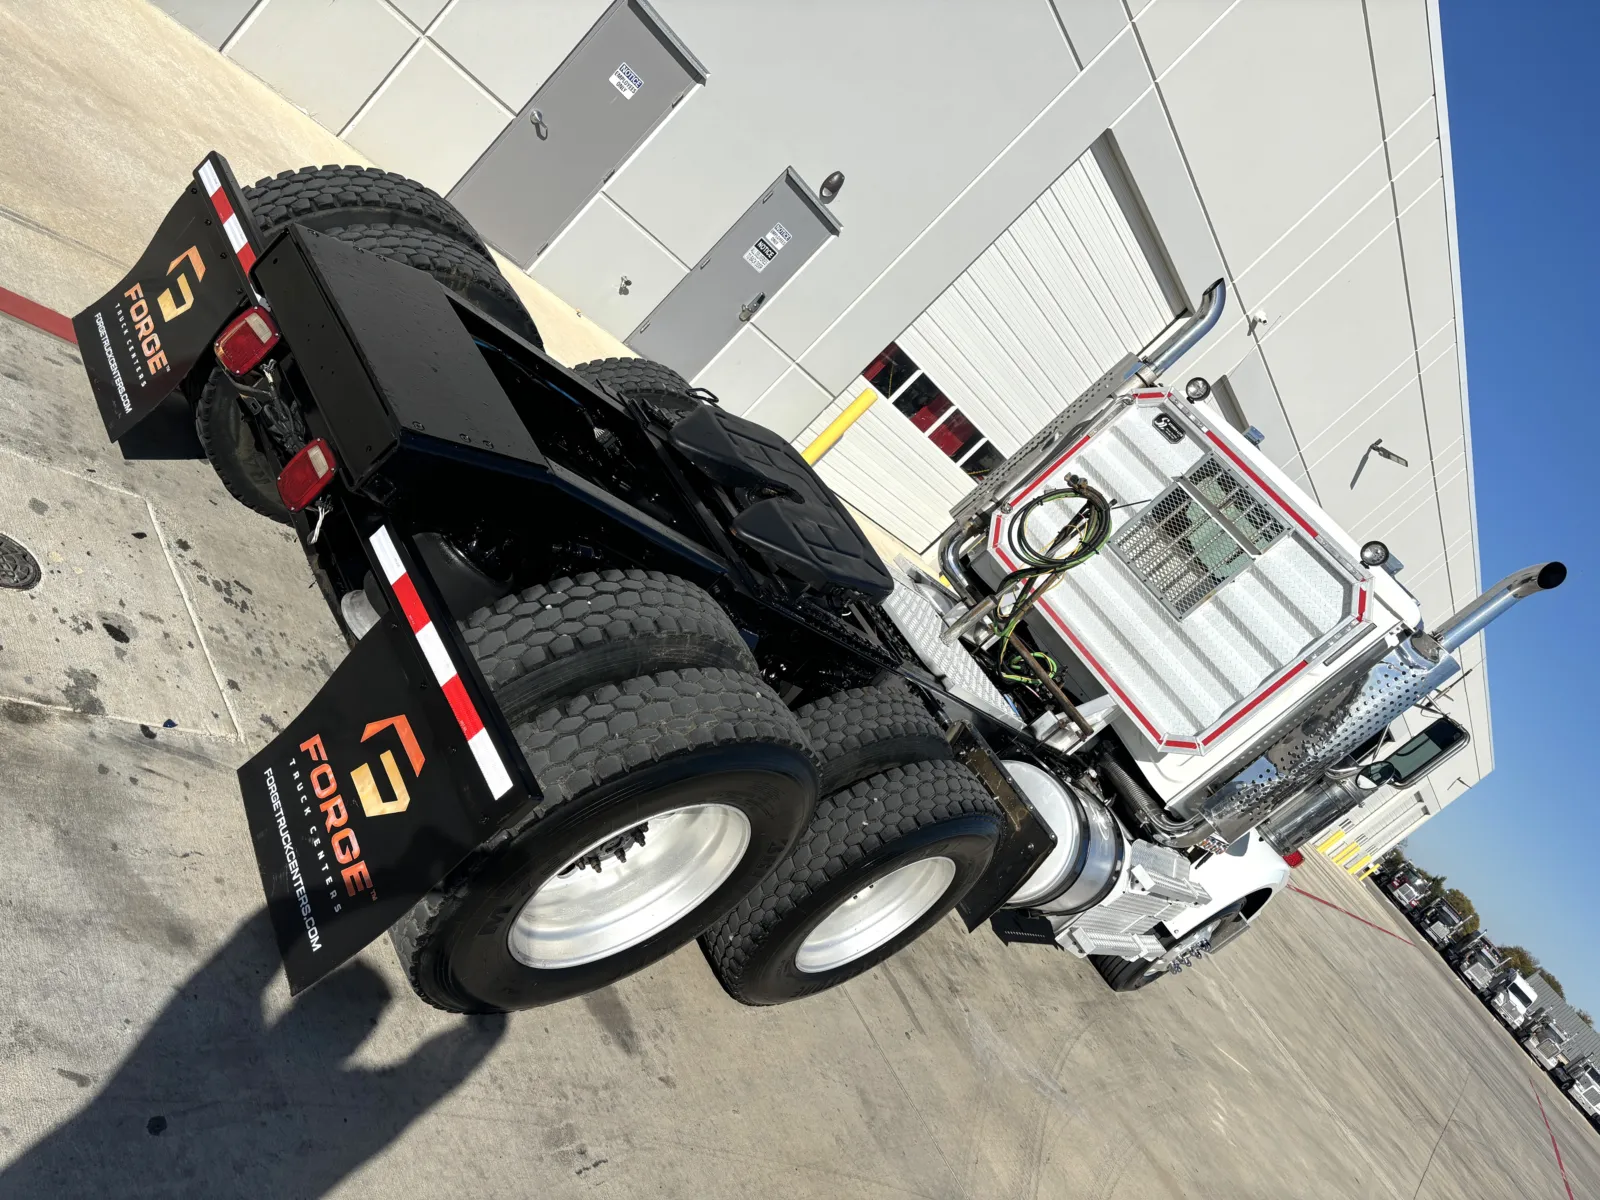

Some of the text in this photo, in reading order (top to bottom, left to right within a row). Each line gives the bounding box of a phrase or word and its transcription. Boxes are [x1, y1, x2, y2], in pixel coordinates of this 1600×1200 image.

[614, 71, 636, 94] EMPLOYEES
[616, 81, 627, 92] ONLY
[620, 65, 642, 88] NOTICE
[757, 241, 775, 259] NOTICE
[775, 224, 791, 241] NOTICE
[94, 312, 133, 414] FORGETRUCKCENTERS.COM
[114, 303, 147, 387] TRUCK CENTERS
[124, 282, 168, 375] FORGE
[288, 758, 342, 913] TRUCK CENTERS
[299, 733, 373, 896] FORGE
[263, 767, 322, 952] FORGETRUCKCENTERS.COM
